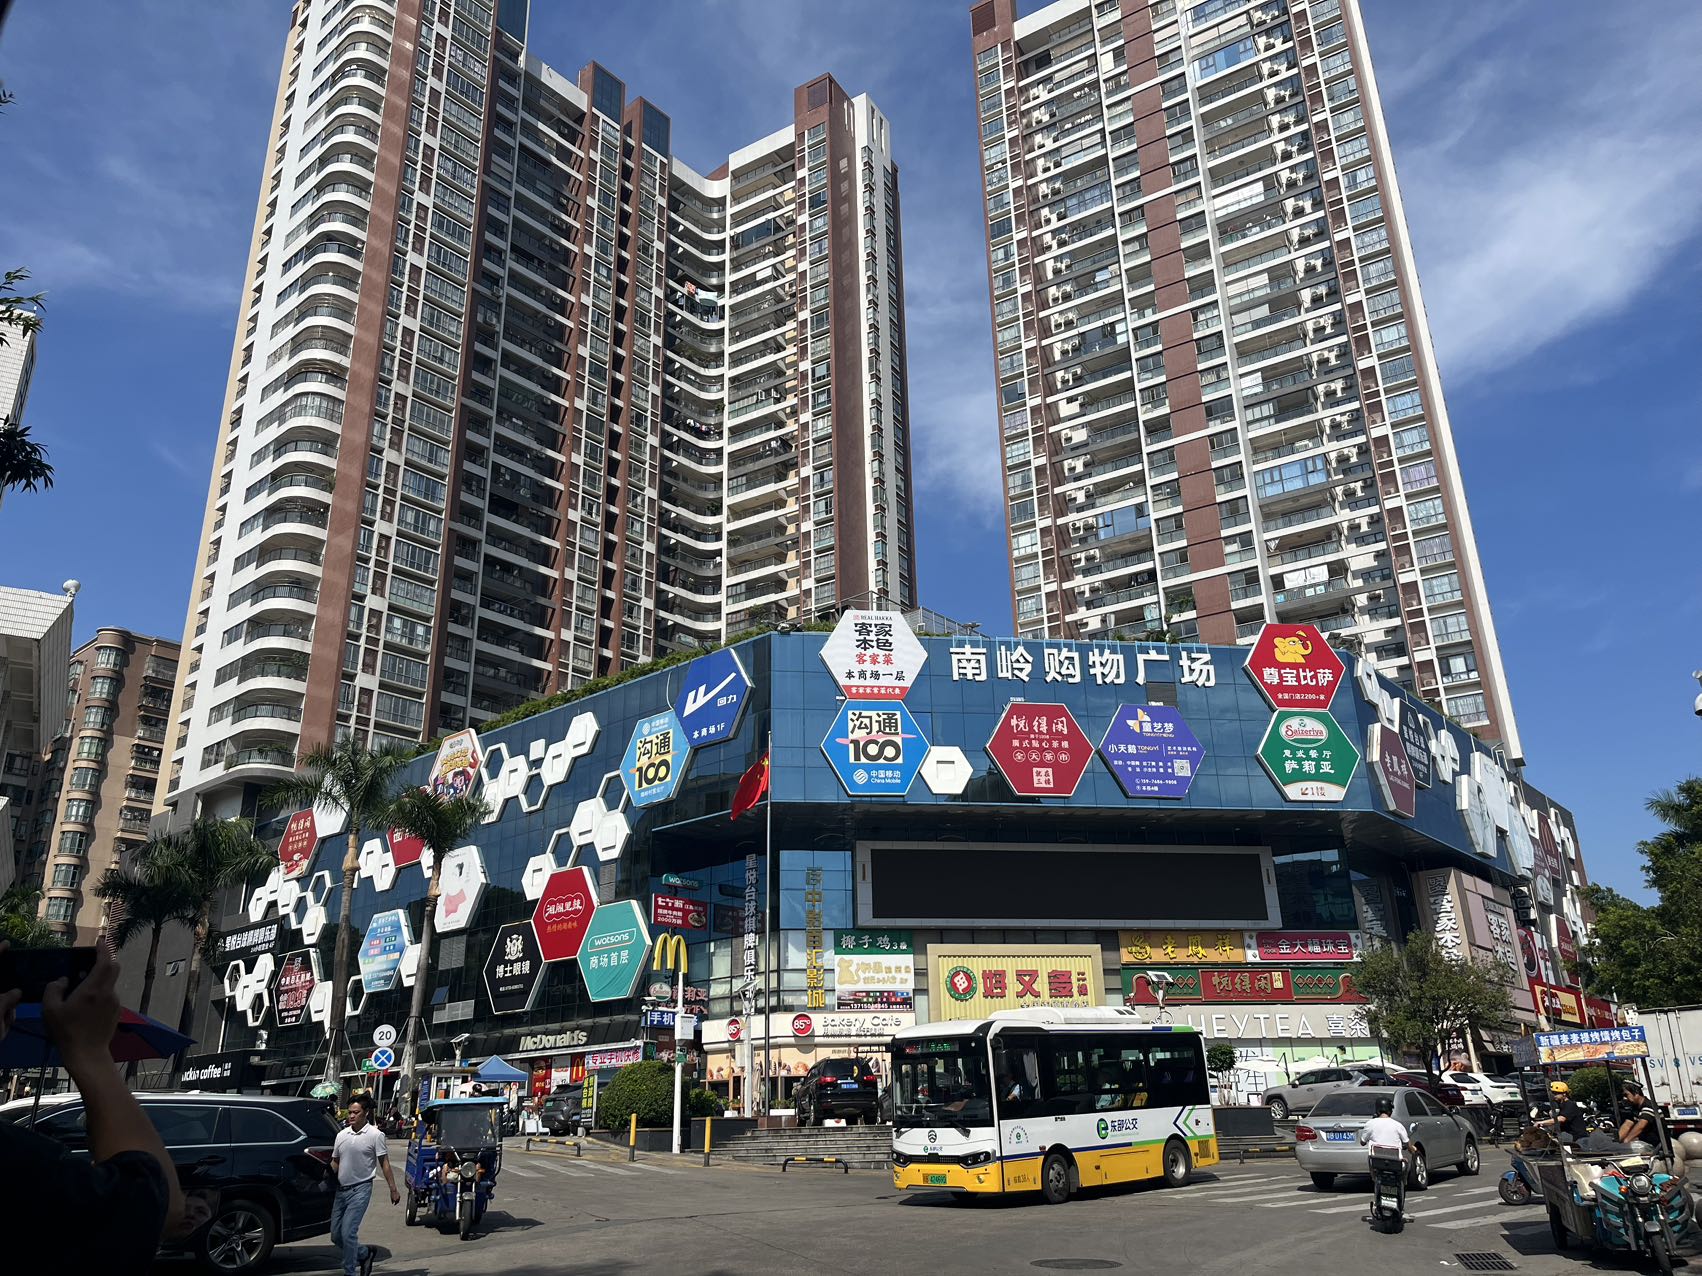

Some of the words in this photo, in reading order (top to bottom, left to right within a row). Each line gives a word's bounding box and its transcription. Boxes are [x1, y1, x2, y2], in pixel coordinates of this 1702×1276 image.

[854, 622, 893, 637] 客家
[855, 637, 894, 652] 本色
[855, 652, 894, 665] 客家菜
[950, 645, 1216, 687] 南岭购物广场
[845, 669, 906, 681] 本商场一层
[1262, 667, 1334, 686] 尊宝比萨
[717, 694, 737, 707] 回力
[692, 722, 725, 740] 本商场1F
[850, 712, 900, 735] 沟通
[1011, 715, 1068, 734] 悦得闲
[1142, 722, 1174, 733] 童艺梦
[1285, 725, 1324, 738] Saizeriya
[637, 731, 671, 763] 沟通
[849, 739, 902, 762] 100
[1109, 744, 1136, 754] 小天鹅
[1283, 750, 1332, 758] 意式餐厅
[1014, 751, 1069, 762] 全天茶市
[636, 758, 671, 789] 100
[871, 770, 901, 778] 中国移动
[1284, 760, 1335, 773] 萨莉亚
[743, 853, 758, 998] 星悦台球棋牌俱乐
[594, 932, 629, 946] watsons
[841, 934, 891, 949] 椰子鸡
[1278, 938, 1349, 953] 金大福珠宝
[589, 950, 629, 970] 商场首层
[496, 960, 530, 979] 博士眼镜
[982, 969, 1074, 999] 好又多
[1212, 972, 1272, 993] 悦得闲
[822, 1016, 866, 1028] Bakery
[1188, 1014, 1316, 1038] HEYTEA
[1326, 1014, 1369, 1038] 喜茶
[378, 1031, 391, 1040] 20
[519, 1030, 588, 1051] McDonald's
[1539, 1028, 1642, 1047] 新疆麦麦提烤馕烤包子
[200, 1064, 221, 1080] coffee
[1110, 1118, 1139, 1133] 东部公交
